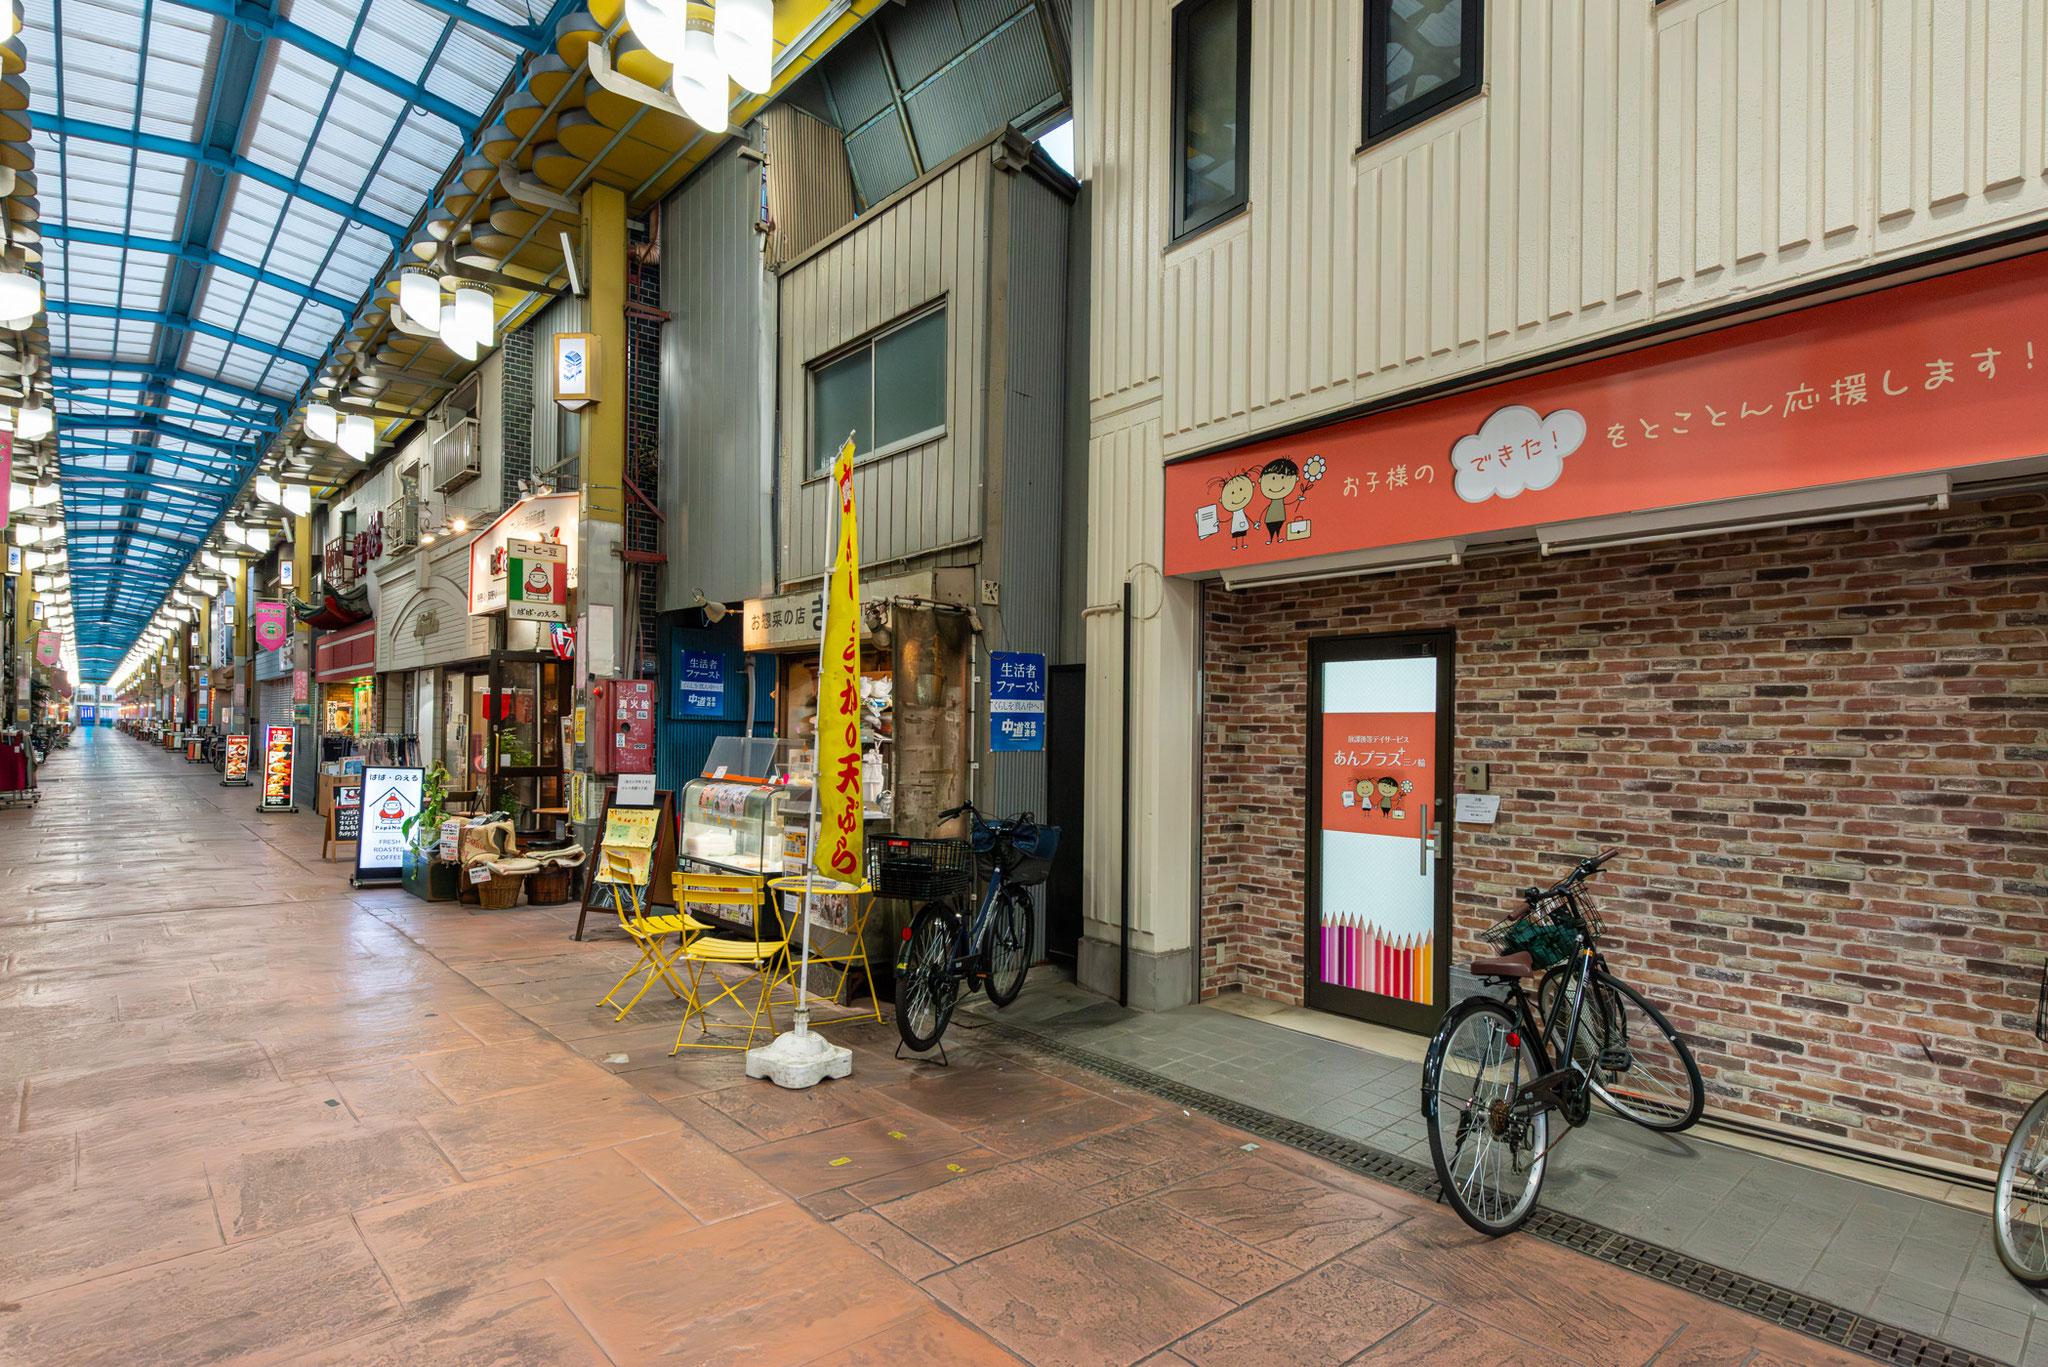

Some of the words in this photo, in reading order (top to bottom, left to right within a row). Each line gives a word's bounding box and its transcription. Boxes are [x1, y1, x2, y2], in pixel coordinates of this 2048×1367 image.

[1470, 431, 1559, 473] できた！
[1343, 464, 1434, 498] お子様の
[517, 543, 558, 557] コーヒー豆
[751, 606, 805, 631] お惣菜の店
[690, 658, 718, 670] 生活者
[1000, 662, 1037, 679] 生活者
[686, 669, 720, 679] ファースト
[996, 681, 1040, 693] ファースト
[619, 699, 649, 710] 消火栓
